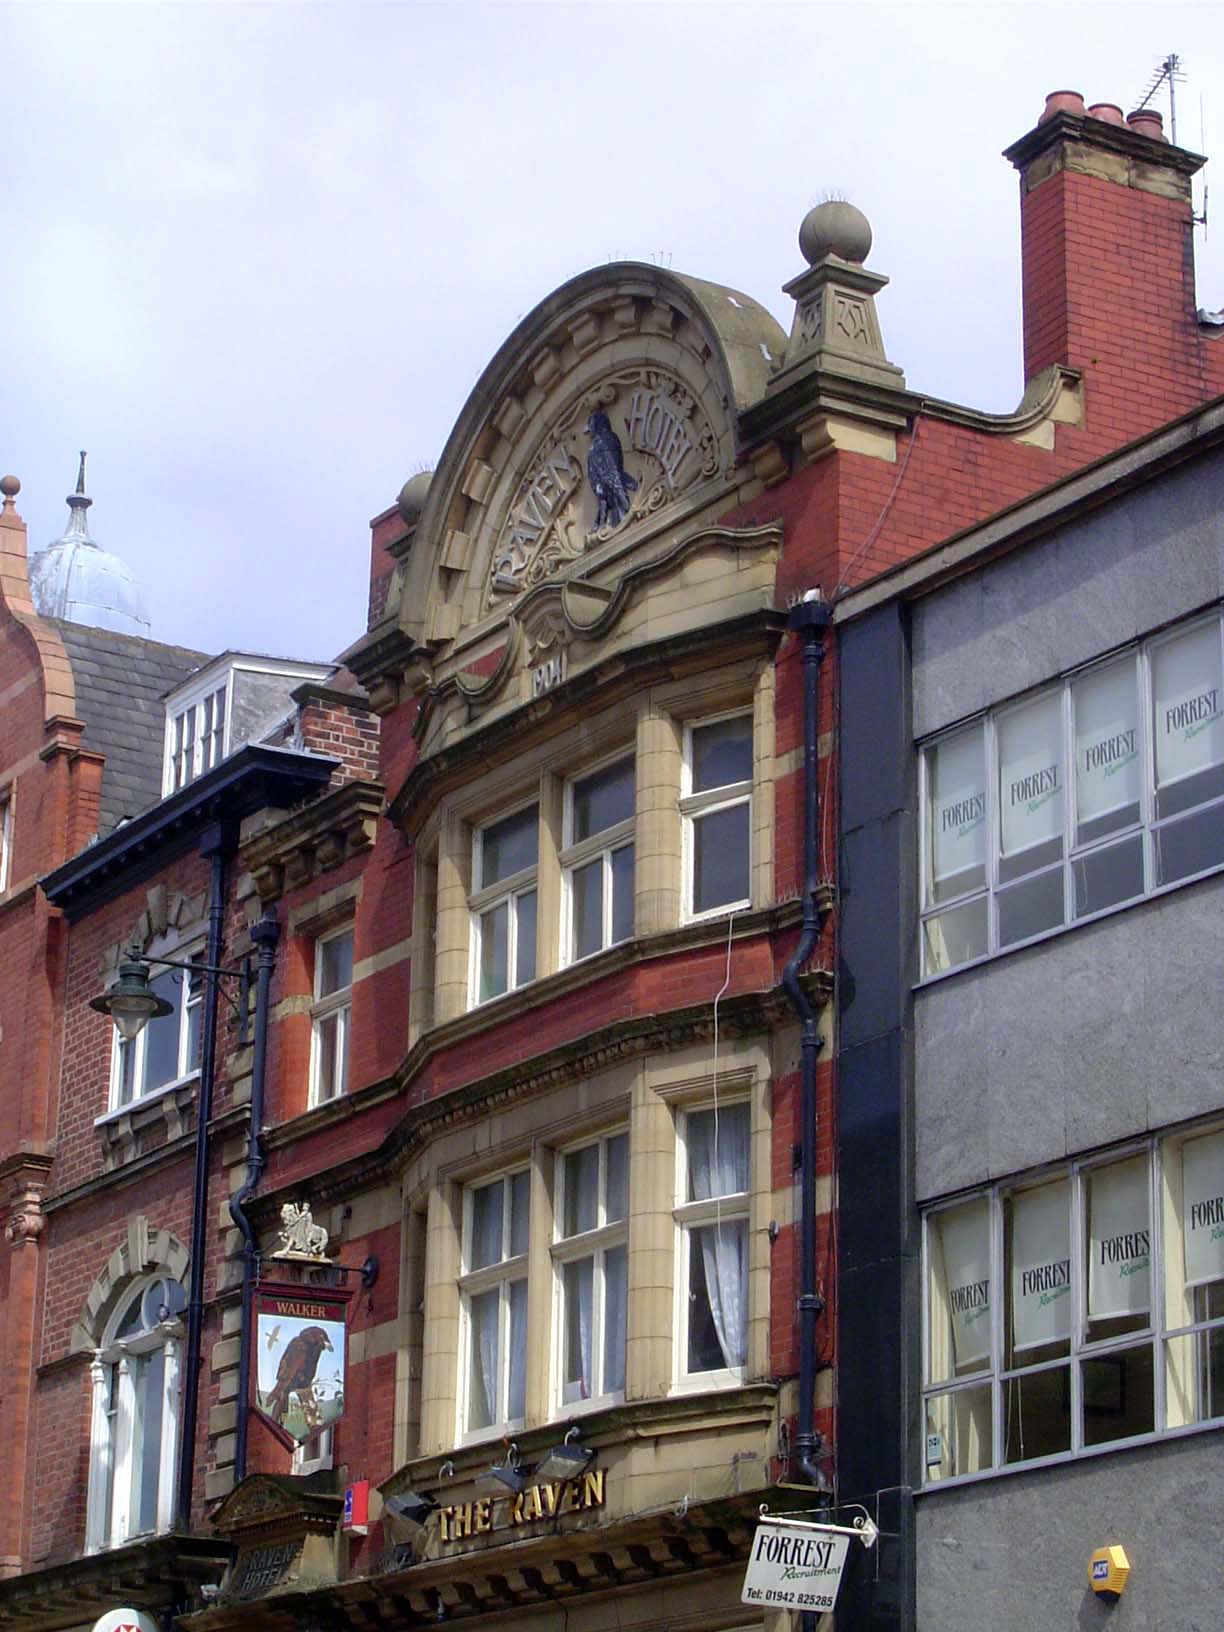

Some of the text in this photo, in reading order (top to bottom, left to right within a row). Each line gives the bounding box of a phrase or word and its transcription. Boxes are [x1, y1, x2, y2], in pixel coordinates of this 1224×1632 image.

[629, 390, 692, 489] HOTEL
[1165, 688, 1220, 734] FORREST
[1084, 728, 1136, 772] FORREST
[1010, 764, 1058, 806] FORREST
[942, 792, 986, 832] FORREST
[1022, 1259, 1071, 1296] FORREST
[276, 1302, 326, 1318] WALKER
[951, 1279, 990, 1315] FORREST
[436, 1468, 607, 1541] THE RAVEN
[755, 1534, 836, 1569] FORREST
[240, 1567, 283, 1591] HOTEL
[781, 1565, 841, 1581] Recruitment
[747, 1587, 834, 1607] Tel: 01942 825285
